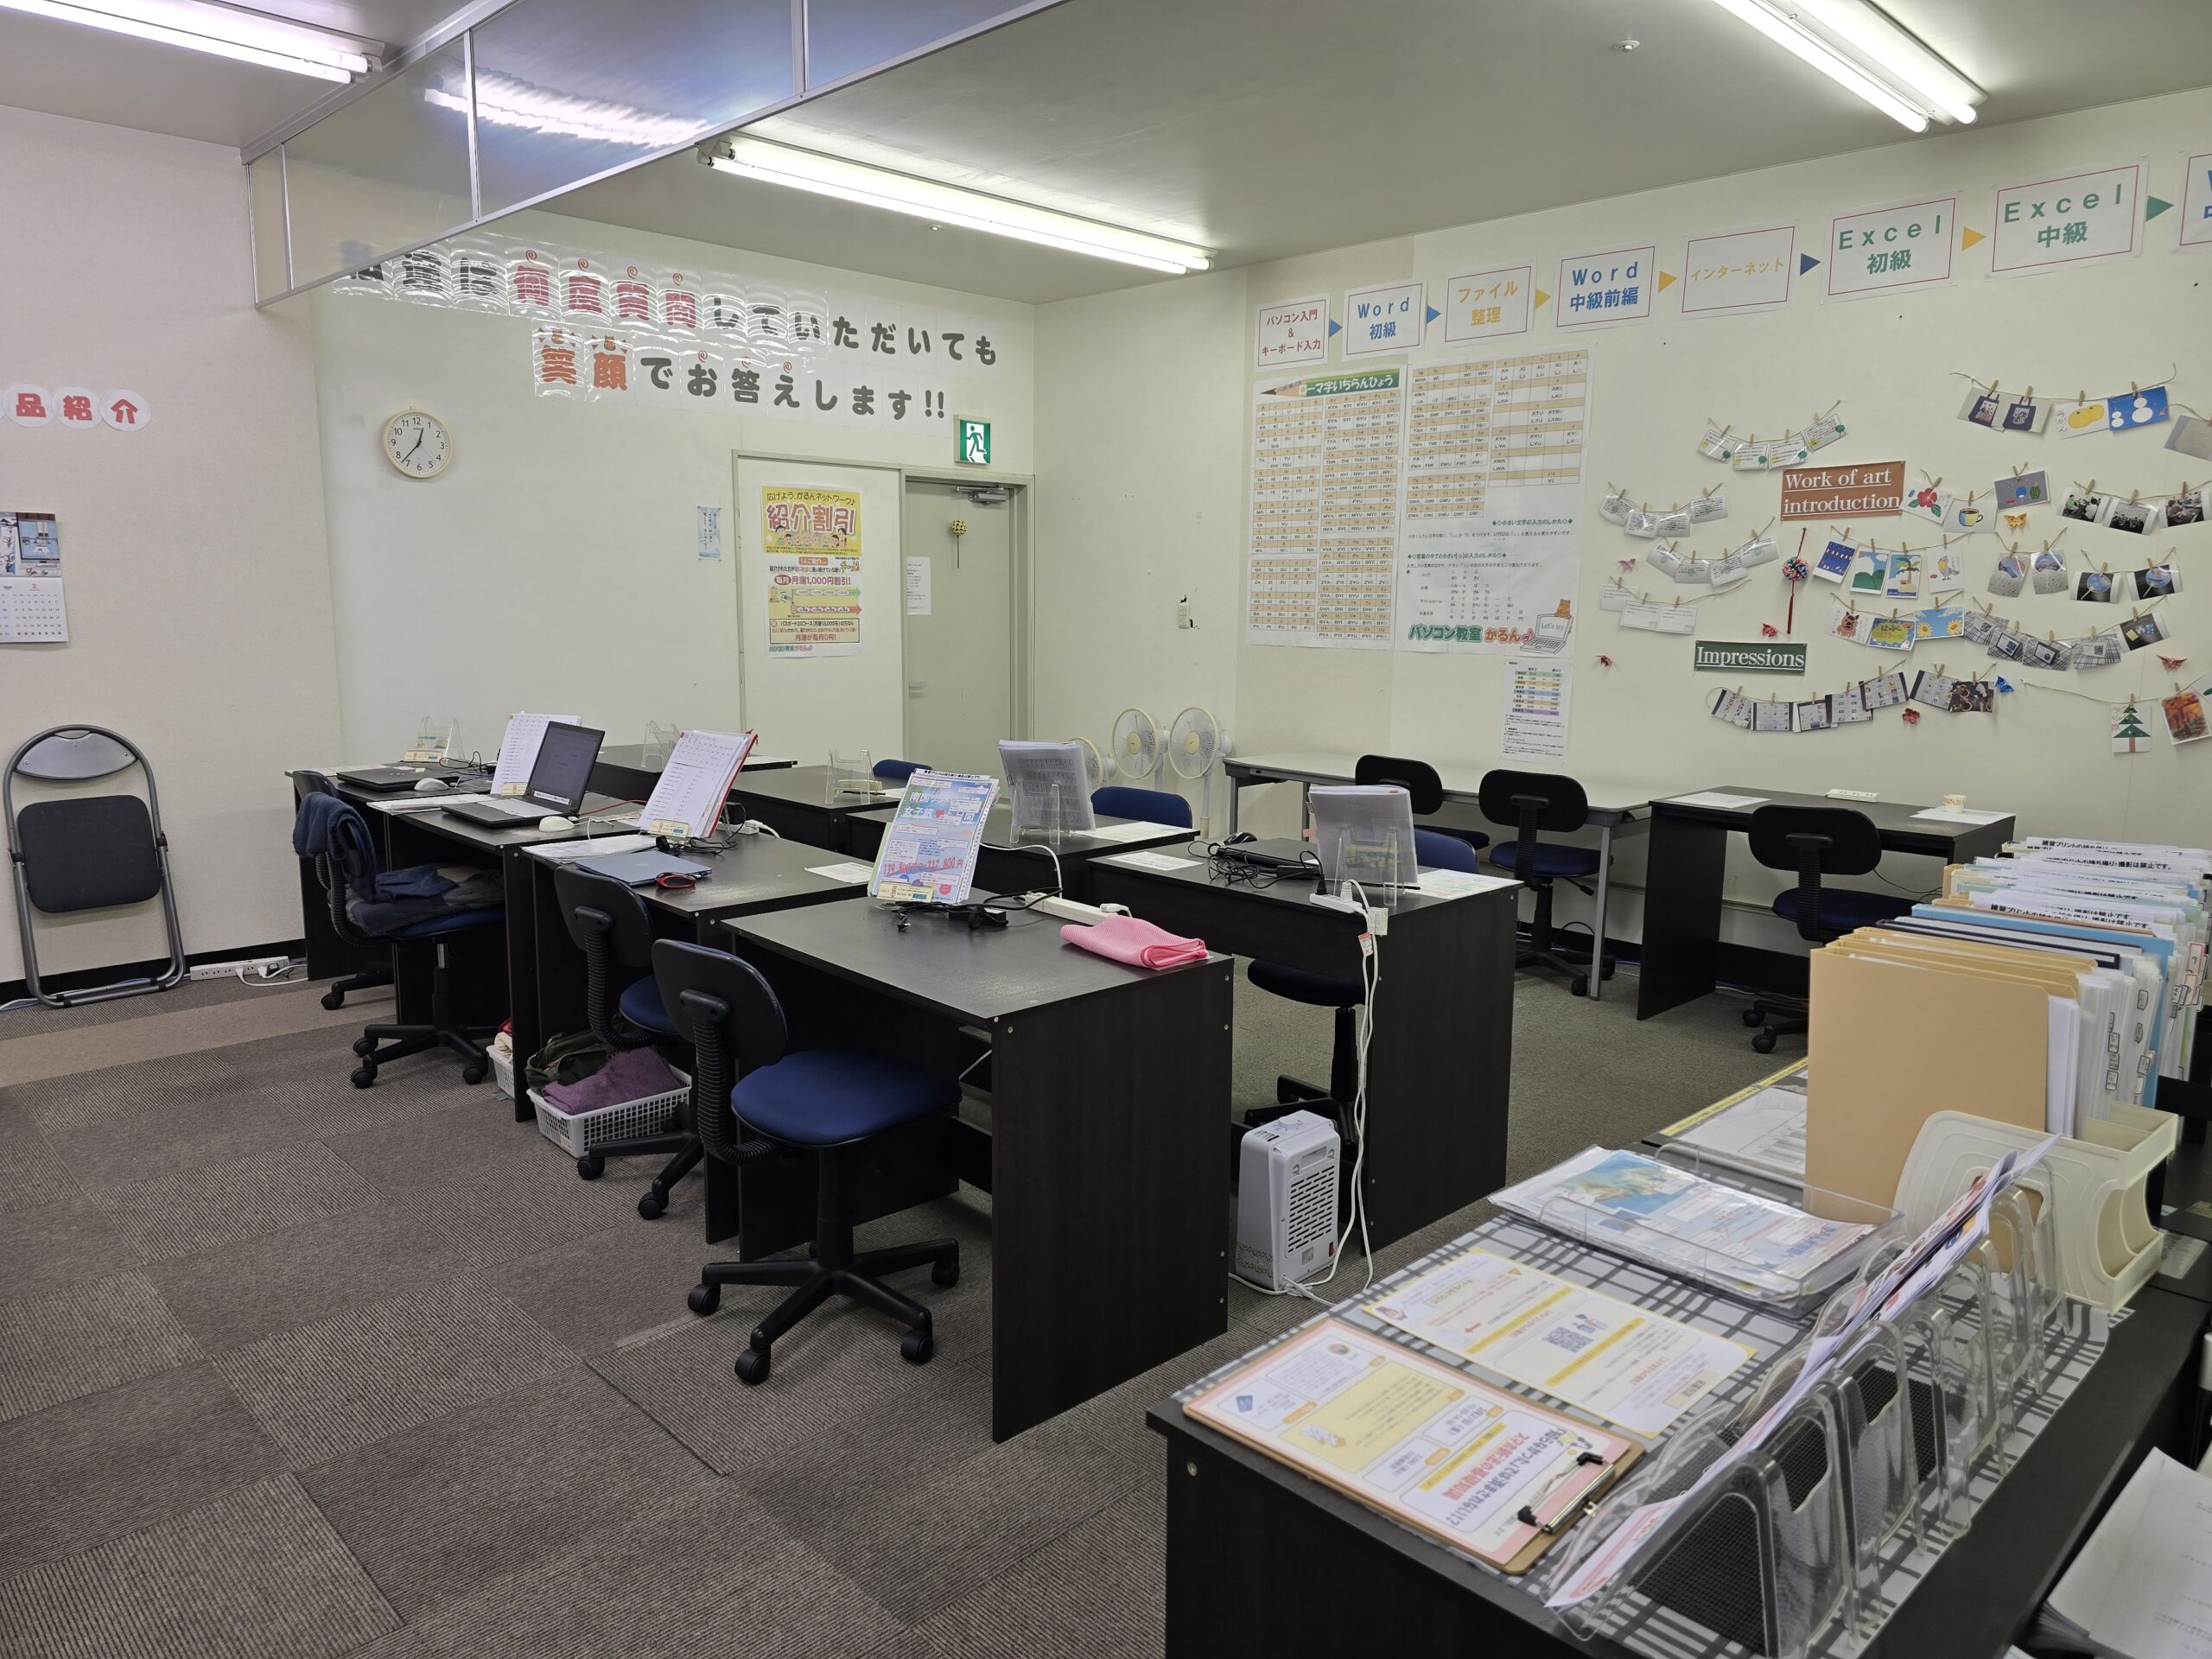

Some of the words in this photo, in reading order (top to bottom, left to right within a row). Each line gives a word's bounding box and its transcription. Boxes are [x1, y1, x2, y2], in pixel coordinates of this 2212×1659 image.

[2005, 183, 2122, 223] Excel
[1839, 215, 1941, 250] Excel
[2037, 221, 2088, 248] 中級
[1572, 261, 1638, 286] Word
[1691, 257, 1784, 282] インターネット
[1867, 249, 1911, 275] 初級
[1458, 281, 1518, 303] ファイル
[1570, 286, 1639, 312] 中級前編
[1266, 309, 1318, 326] パソコン入門
[1357, 296, 1409, 319] Word
[1471, 306, 1501, 327] 整理
[1287, 327, 1294, 338] &
[1369, 321, 1396, 340] 初級
[1262, 339, 1321, 356] キーボード入力
[1785, 473, 1833, 489] Work
[1838, 470, 1857, 486] of
[1863, 468, 1891, 484] art
[1783, 493, 1900, 513] introduction
[766, 503, 855, 533] 紹介割引
[1408, 624, 1483, 643] パソコン教室
[1484, 627, 1521, 644] かるん
[1696, 646, 1804, 669] Impressions
